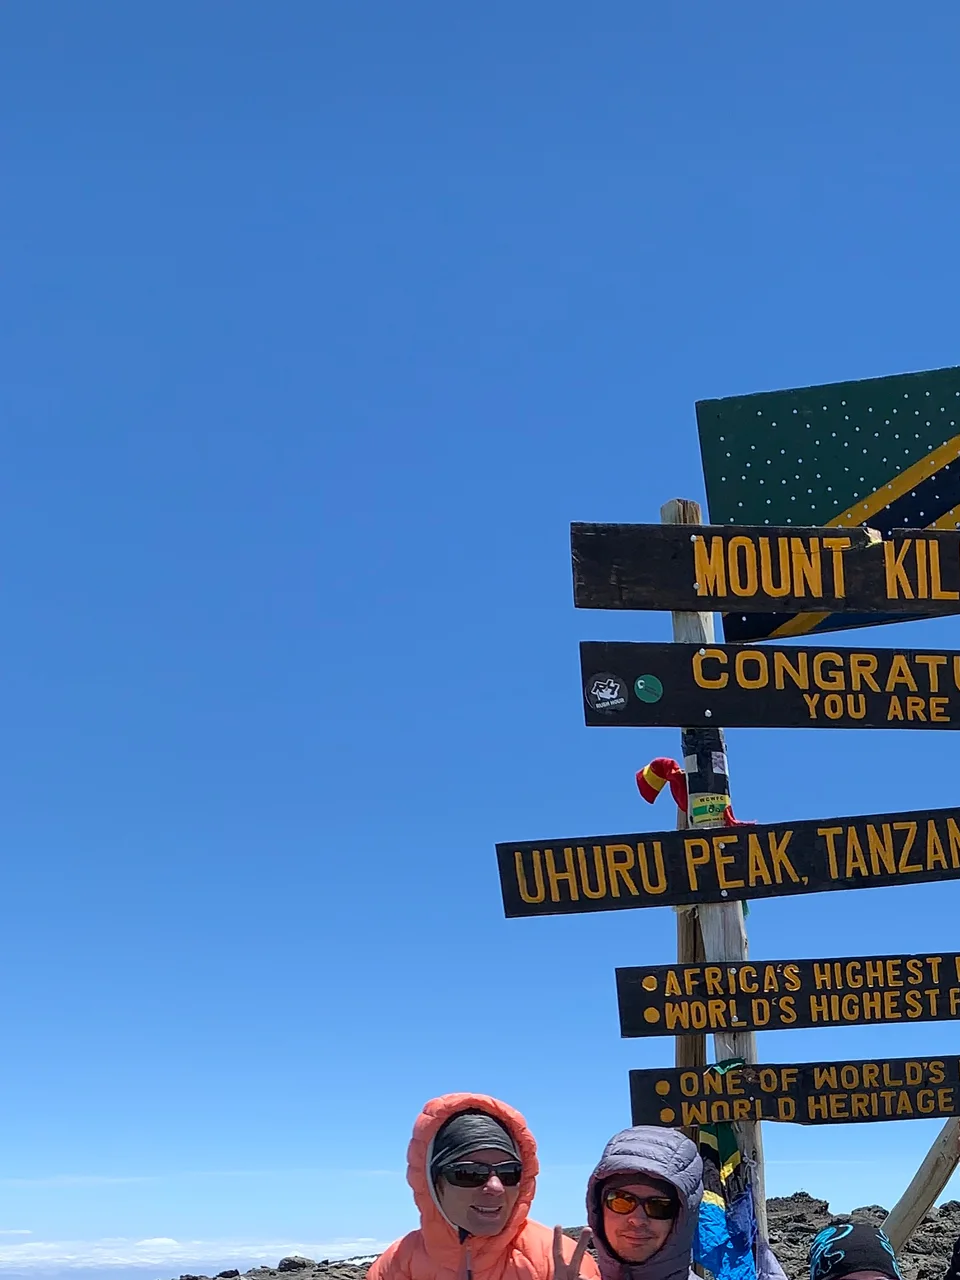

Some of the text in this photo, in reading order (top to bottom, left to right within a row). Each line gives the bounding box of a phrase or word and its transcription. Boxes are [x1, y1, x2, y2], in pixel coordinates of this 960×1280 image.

[694, 535, 851, 598] MOUNT
[803, 694, 866, 719] YOU
[887, 696, 950, 721] ARE
[514, 841, 667, 903] UHURU
[684, 830, 809, 891] PEAK,
[665, 964, 801, 996] AFRICA'S
[814, 957, 942, 990] HIGHEST
[665, 996, 797, 1030] WORLD'S
[810, 988, 940, 1022] HIGHEST
[681, 1071, 745, 1097] ONE
[760, 1068, 799, 1093] OF
[814, 1061, 945, 1090] WORLD'S
[808, 1088, 953, 1120] HERITAGE
